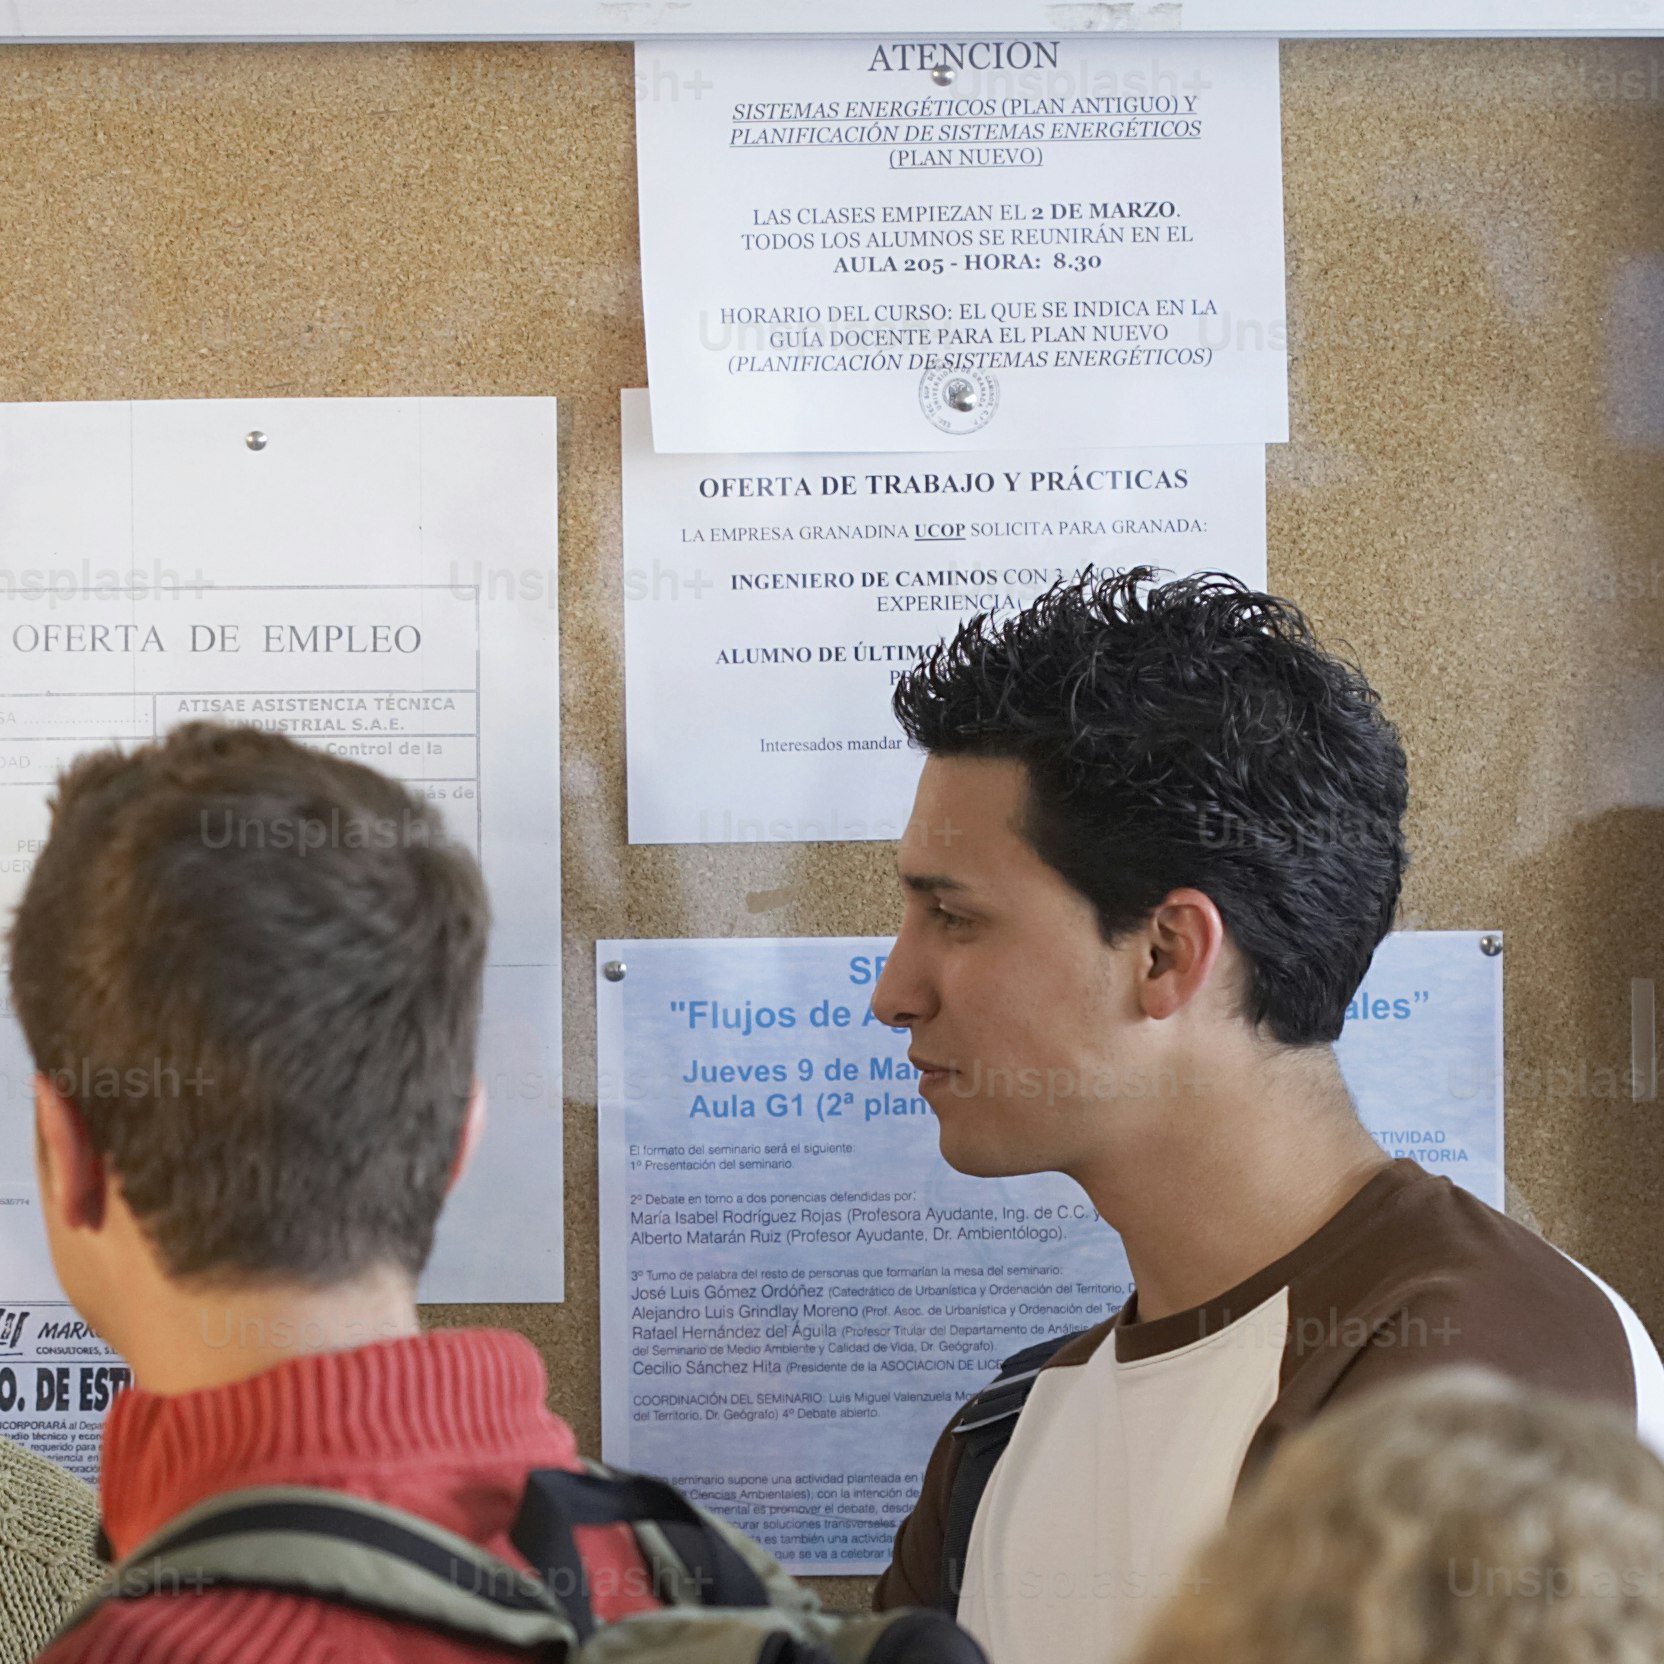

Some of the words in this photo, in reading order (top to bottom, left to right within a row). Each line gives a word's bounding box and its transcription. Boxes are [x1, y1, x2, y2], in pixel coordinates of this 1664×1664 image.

[732, 102, 840, 120] SISTEMAS
[844, 96, 997, 118] ENERGÉTICOS
[1001, 98, 1065, 116] (PLAN
[1071, 95, 1178, 114] ANTIGUO)
[1183, 95, 1198, 112] Y
[730, 121, 900, 146] PLANIFICACIÓN
[903, 124, 934, 142] DE
[938, 123, 1045, 141] SISTEMAS
[1049, 117, 1202, 140] ENERGÉTICOS
[889, 149, 953, 167] (PLAN
[959, 147, 1043, 166] NUEVO)
[753, 208, 792, 226] LAS
[797, 207, 876, 225] CLASES
[882, 204, 993, 223] EMPIEZAN
[1000, 204, 1027, 221] EL
[1032, 207, 1044, 221] 2
[1051, 203, 1083, 220] DE
[1089, 201, 1181, 224] MARZO.
[741, 232, 815, 250] TODOS
[821, 231, 861, 249] LOS
[866, 229, 974, 248] ALUMNOS
[979, 229, 1005, 246] SE
[1011, 223, 1125, 246] REUNIRÁN
[1131, 226, 1161, 243] EN
[1167, 225, 1194, 243] EL
[833, 255, 898, 274] AULA
[904, 258, 944, 275] 205
[965, 253, 1041, 271] HORA:
[1053, 253, 1102, 273] 8.30
[699, 477, 812, 498] OFERTA
[822, 475, 857, 496] DE
[865, 472, 995, 495] TRABAJO
[1003, 472, 1021, 492] Y
[1031, 466, 1188, 491] PRÁCTICAS
[682, 528, 705, 543] LA
[710, 526, 794, 542] EMPRESA
[799, 524, 909, 540] GRANADINA
[914, 523, 966, 538] UCOP
[970, 522, 1053, 537] SOLICITA
[1058, 521, 1106, 535] PARA
[1111, 518, 1207, 534] GRANADA:
[732, 572, 855, 590] INGENIERO
[861, 572, 889, 588] DE
[895, 570, 998, 587] CAMINOS
[1004, 568, 1047, 586] CON
[877, 595, 1015, 613] EXPERIENCIA
[12, 624, 165, 652] OFERTA
[189, 624, 240, 652] DE
[263, 624, 421, 653] EMPLEO
[716, 647, 812, 664] ALUMNO
[818, 646, 846, 662] DE
[177, 698, 245, 716] ATISAE
[251, 697, 367, 713] ASISTENCIA
[373, 693, 455, 711] TÉCNICA
[351, 717, 404, 732] S.A.E.
[809, 998, 852, 1036] de
[682, 1060, 788, 1084] Jueves
[798, 1058, 814, 1082] 9
[824, 1057, 859, 1082] de
[688, 1094, 755, 1119] Aula
[765, 1093, 802, 1118] G1
[864, 1091, 934, 1122] plan
[630, 1210, 671, 1225] María
[675, 1209, 718, 1225] Isabel
[722, 1208, 797, 1227] Rodríguez
[800, 1208, 842, 1226] Rojas
[847, 1208, 921, 1226] (Profesora
[925, 1206, 997, 1224] Ayudante,
[1002, 1206, 1029, 1227] Ing.
[1033, 1206, 1053, 1221] de
[35, 1366, 70, 1412] DE
